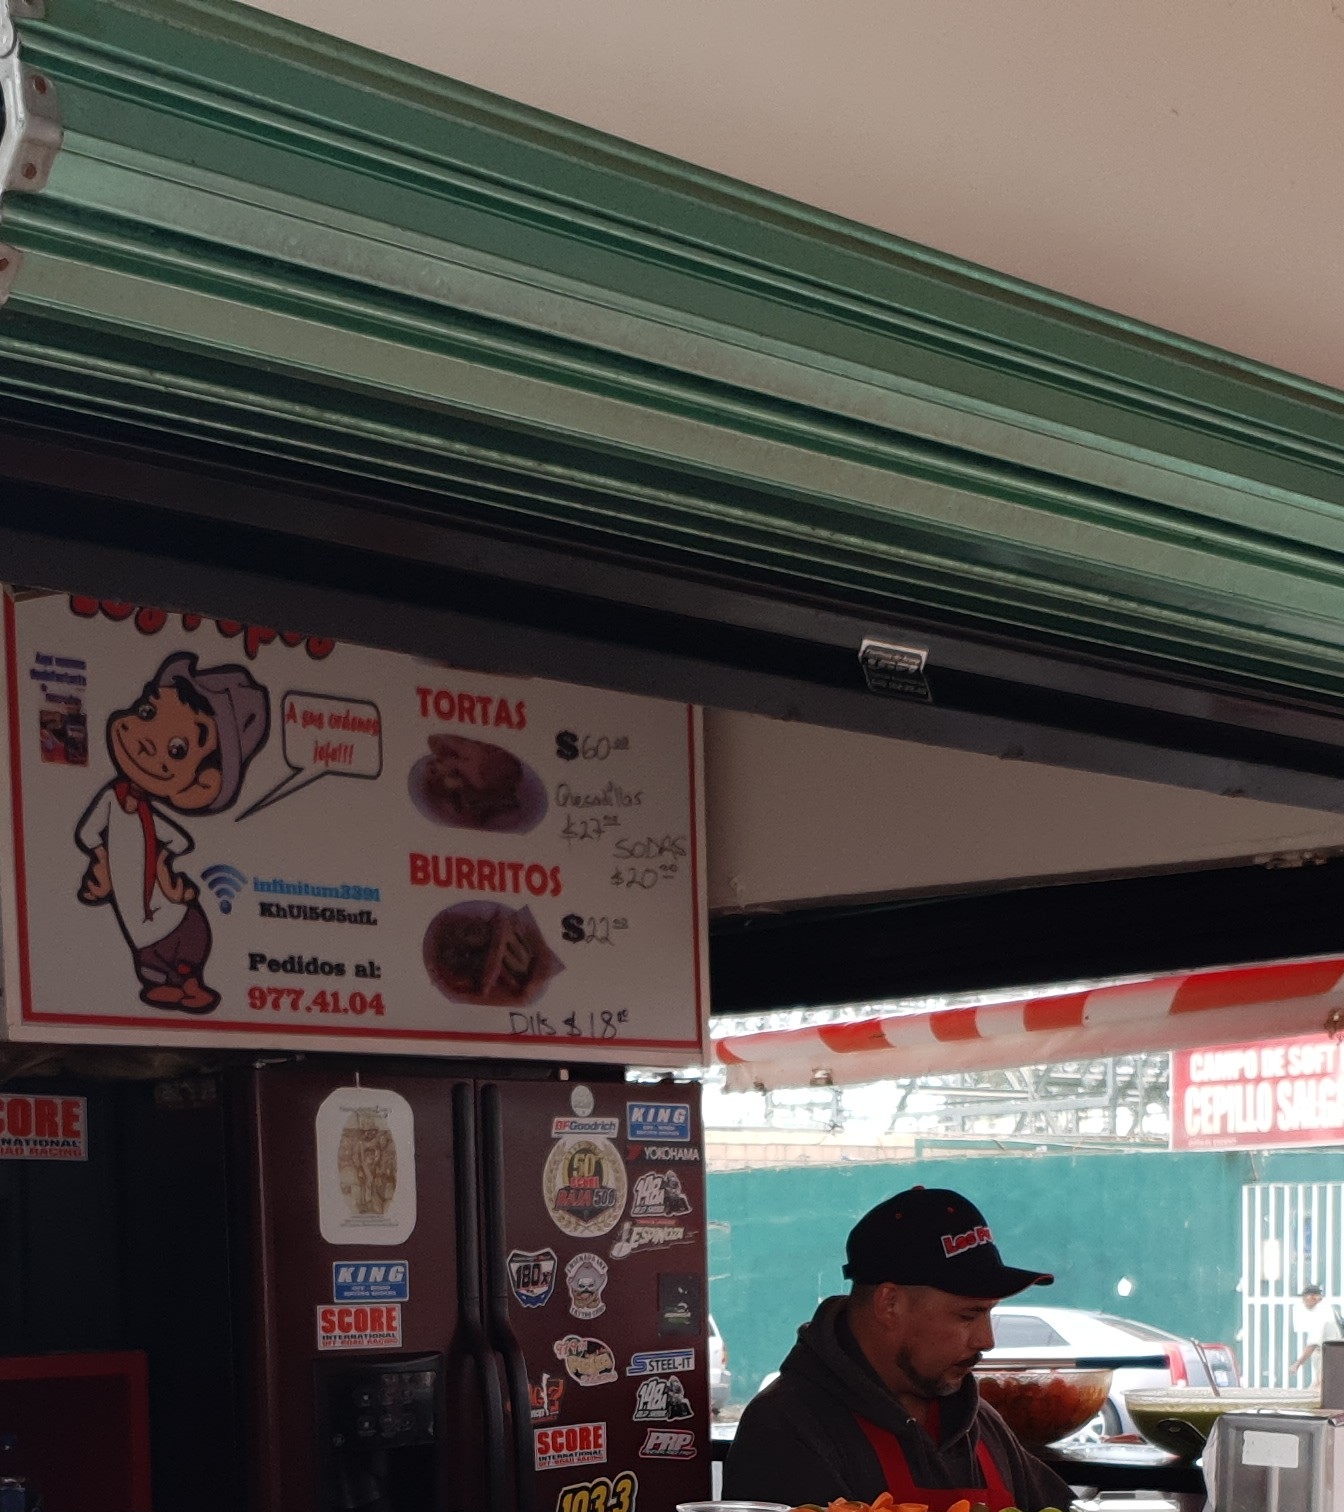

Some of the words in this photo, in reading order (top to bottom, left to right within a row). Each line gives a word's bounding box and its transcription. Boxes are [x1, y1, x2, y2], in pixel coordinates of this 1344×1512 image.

[416, 686, 528, 731] TORTAS
[409, 851, 563, 897] BURRITOS
[248, 952, 346, 976] Pedidos
[248, 986, 385, 1015] 977.41.04
[1189, 1049, 1257, 1083] CAMPO
[1260, 1047, 1286, 1079] DE
[631, 1107, 687, 1124] KING
[1184, 1080, 1273, 1136] CEPILLO
[555, 1121, 617, 1132] BFGoodrich
[643, 1146, 700, 1161] YOKOHAMA
[338, 1265, 406, 1282] KING
[321, 1307, 398, 1334] SCORE
[648, 1357, 692, 1373] STEEL-IT
[537, 1425, 603, 1455] SCORE
